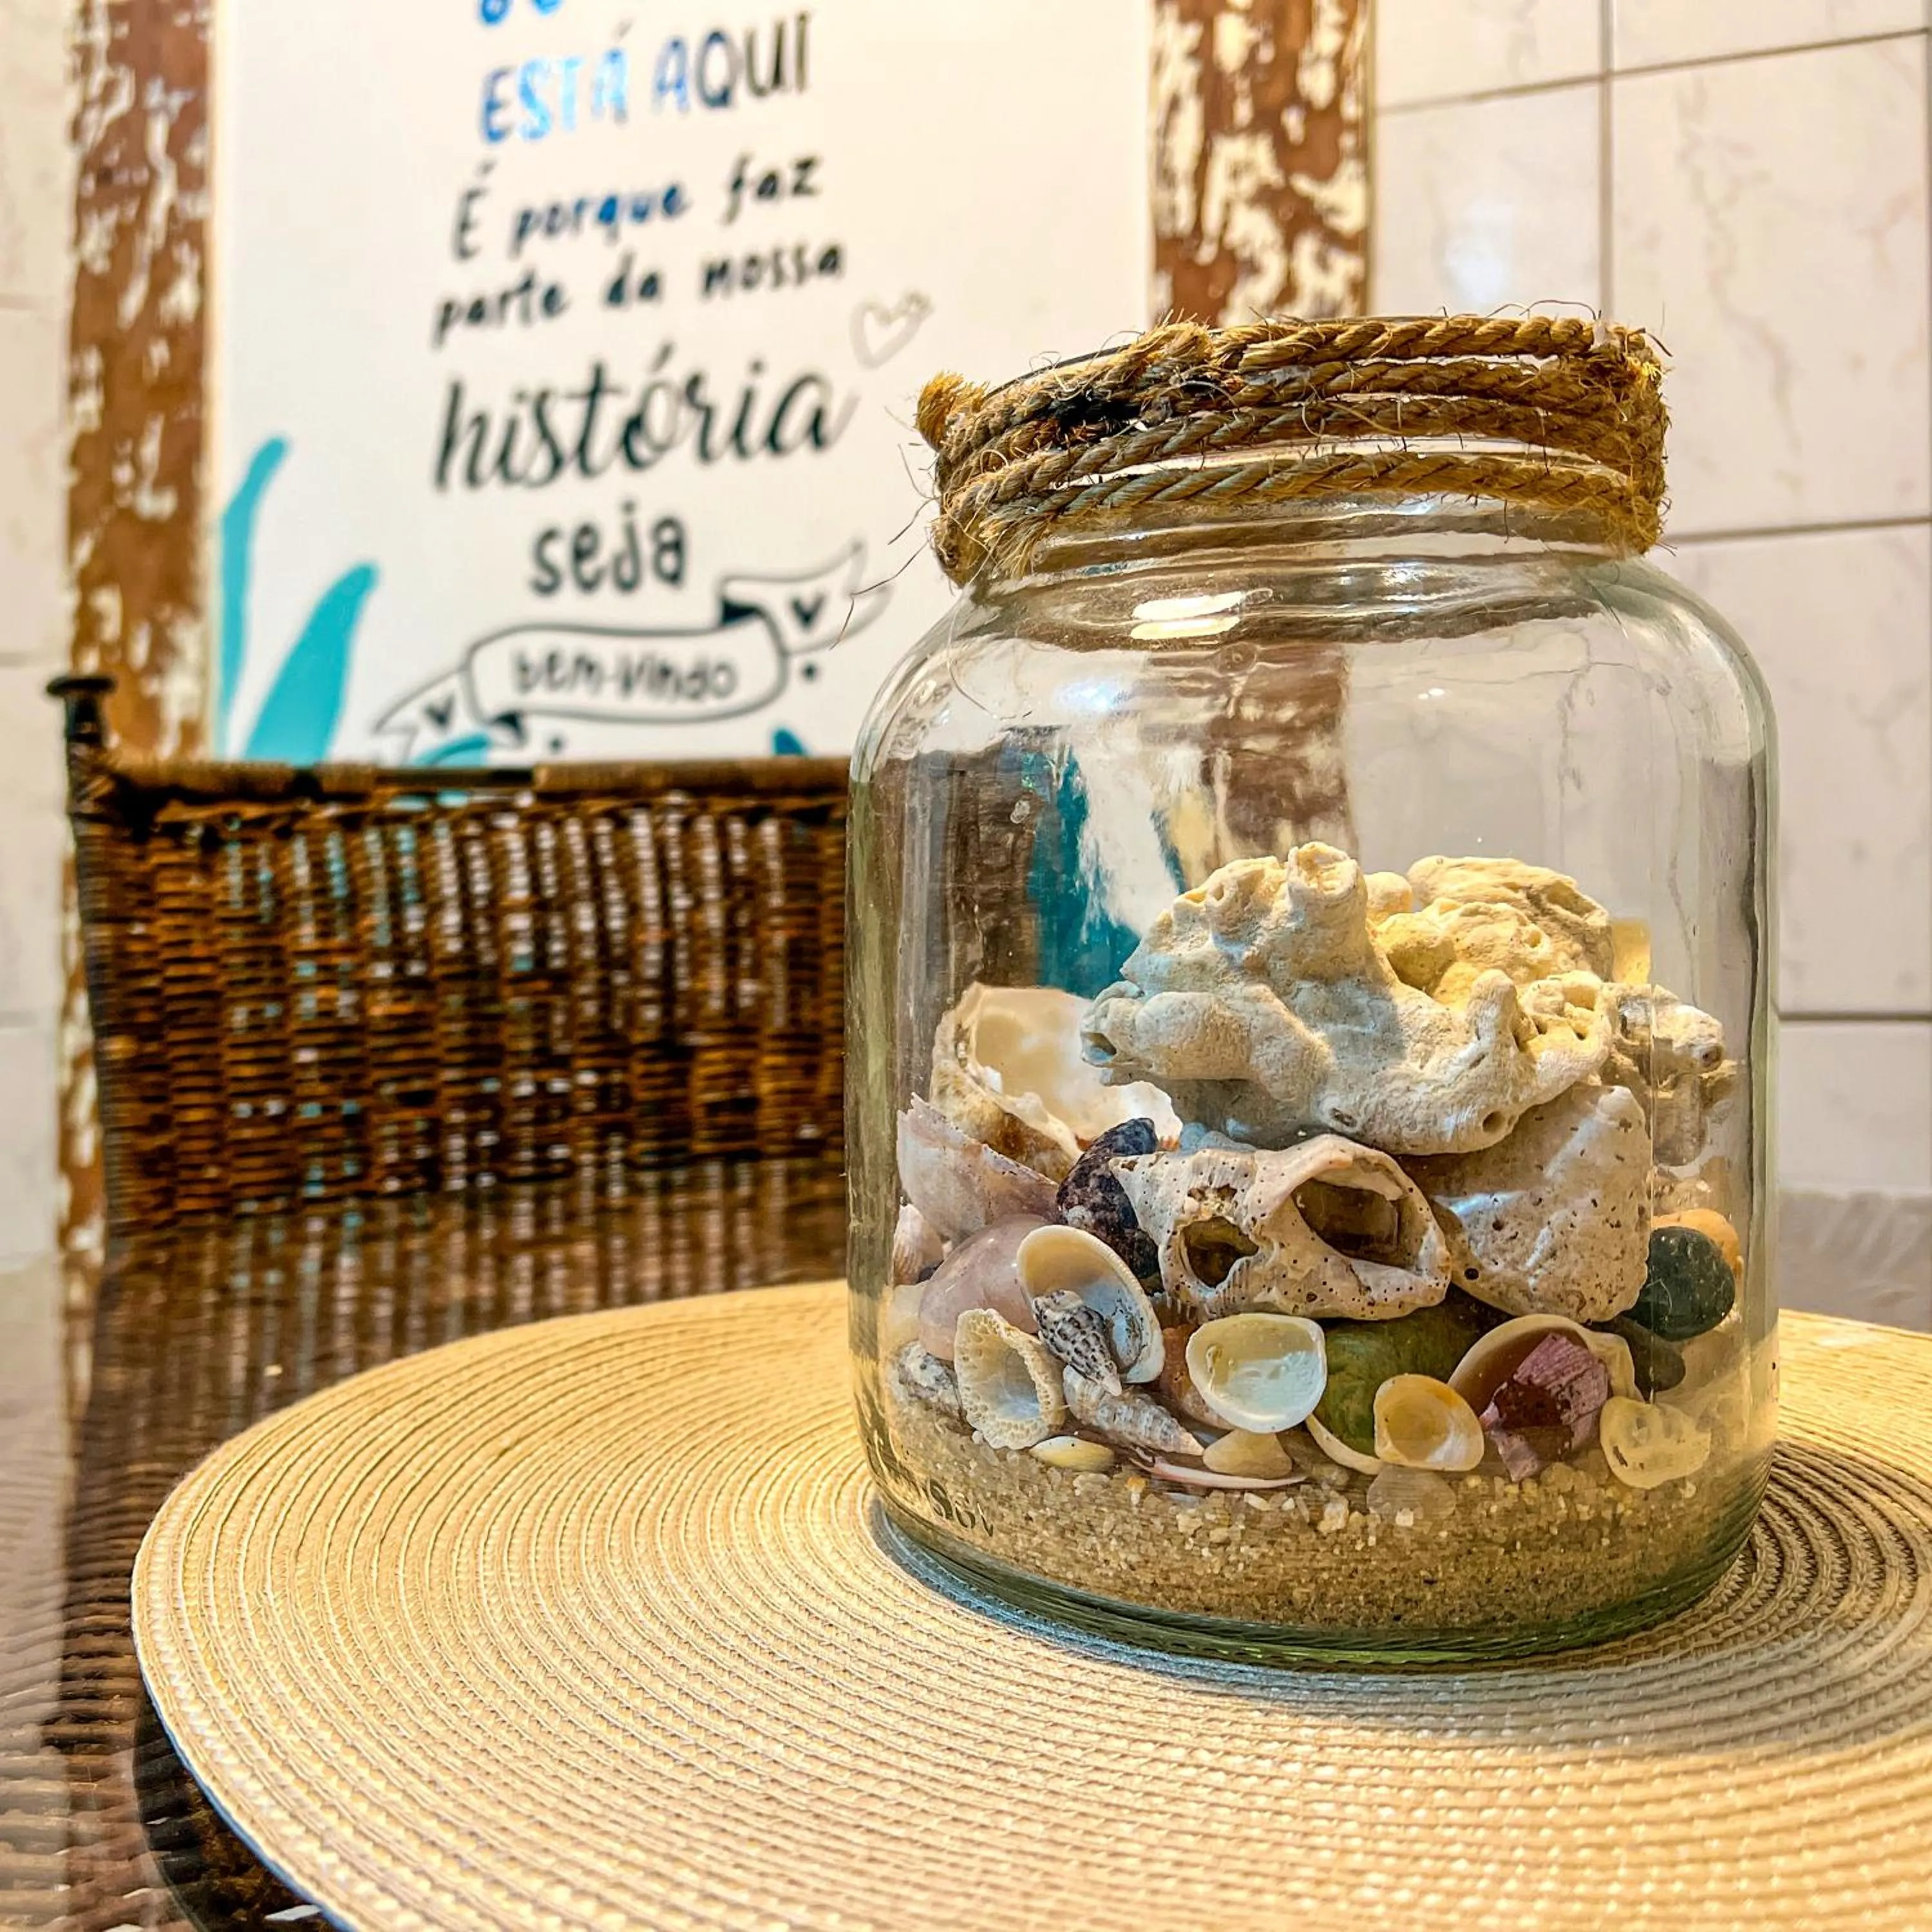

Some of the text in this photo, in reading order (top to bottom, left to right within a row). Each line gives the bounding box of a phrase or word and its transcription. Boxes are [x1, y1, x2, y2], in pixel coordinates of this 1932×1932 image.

[479, 10, 811, 143] ESTÁ AQUI
[452, 153, 821, 262] É porque faz
[433, 242, 846, 348] parte da nossa
[433, 343, 857, 493] história
[529, 500, 688, 596] seja
